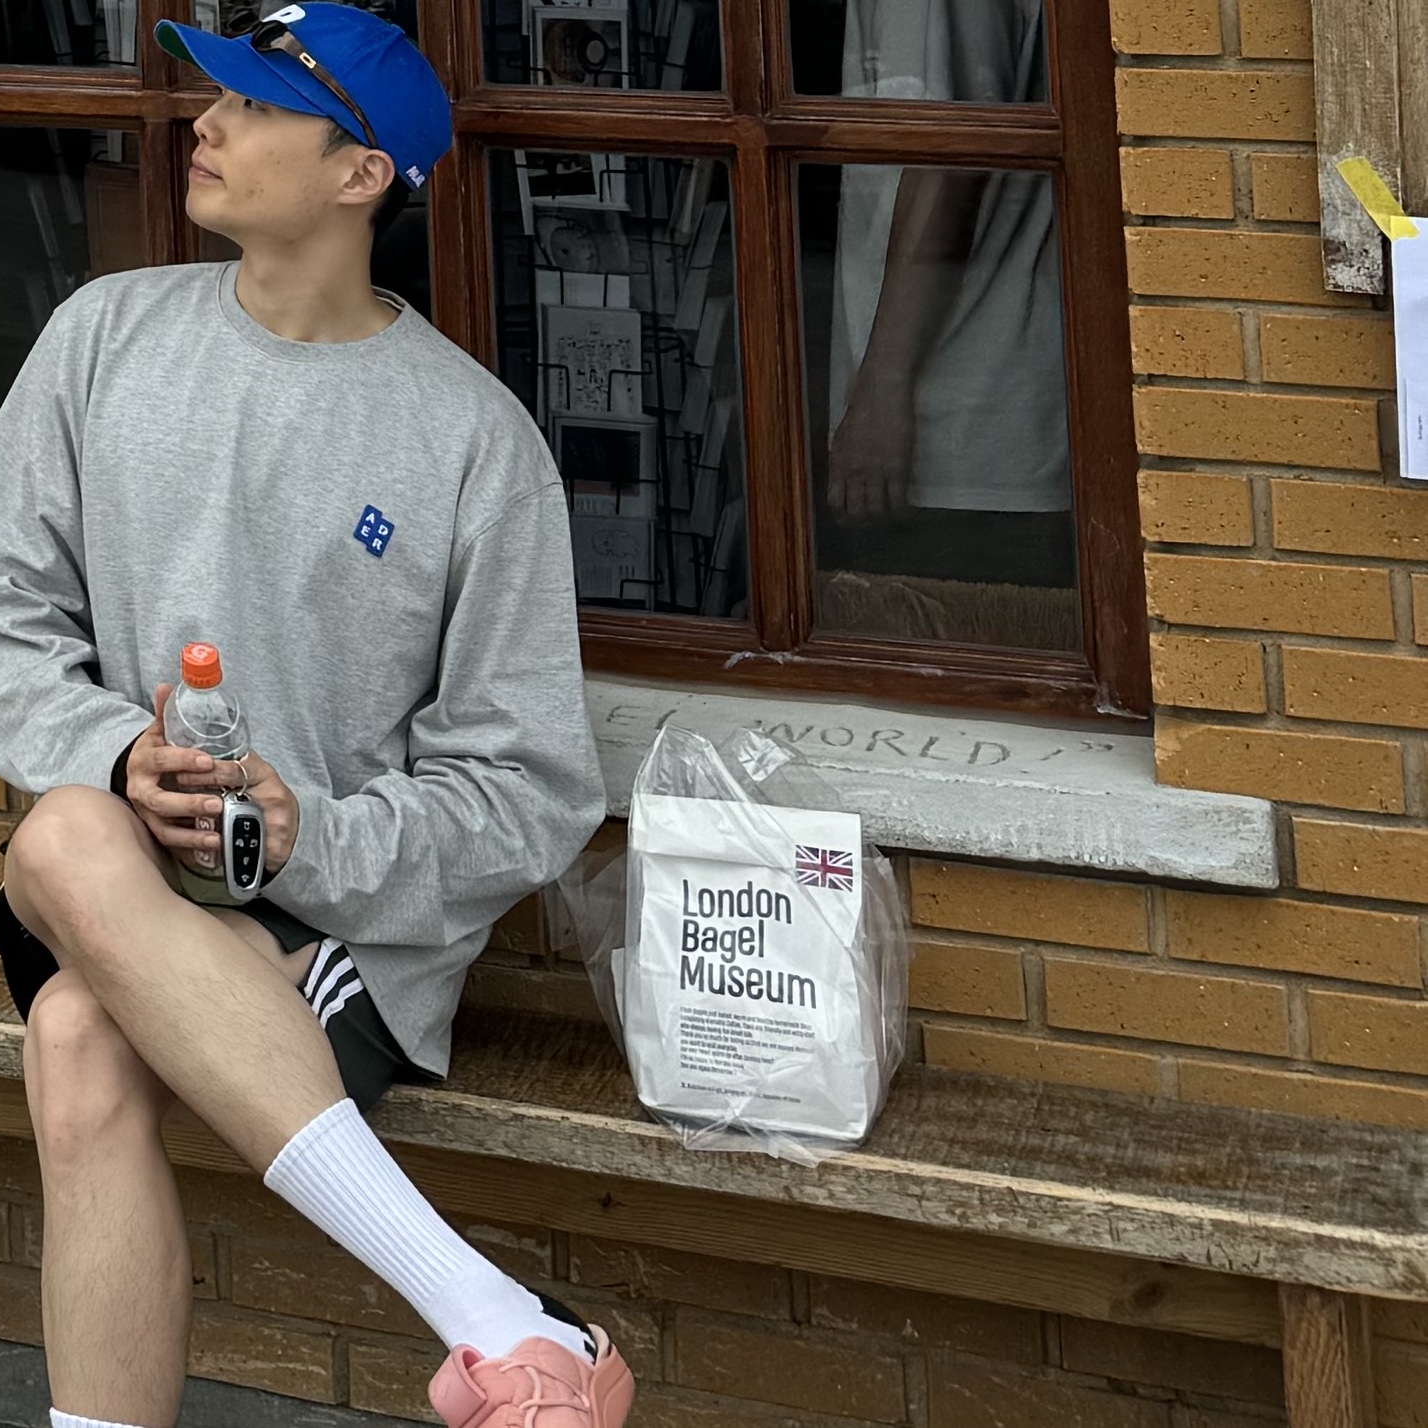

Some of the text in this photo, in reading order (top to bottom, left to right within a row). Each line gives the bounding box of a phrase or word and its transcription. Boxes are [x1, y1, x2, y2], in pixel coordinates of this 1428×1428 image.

[682, 879, 792, 924] London
[680, 919, 764, 964] Bagel
[679, 955, 817, 1009] Museum
